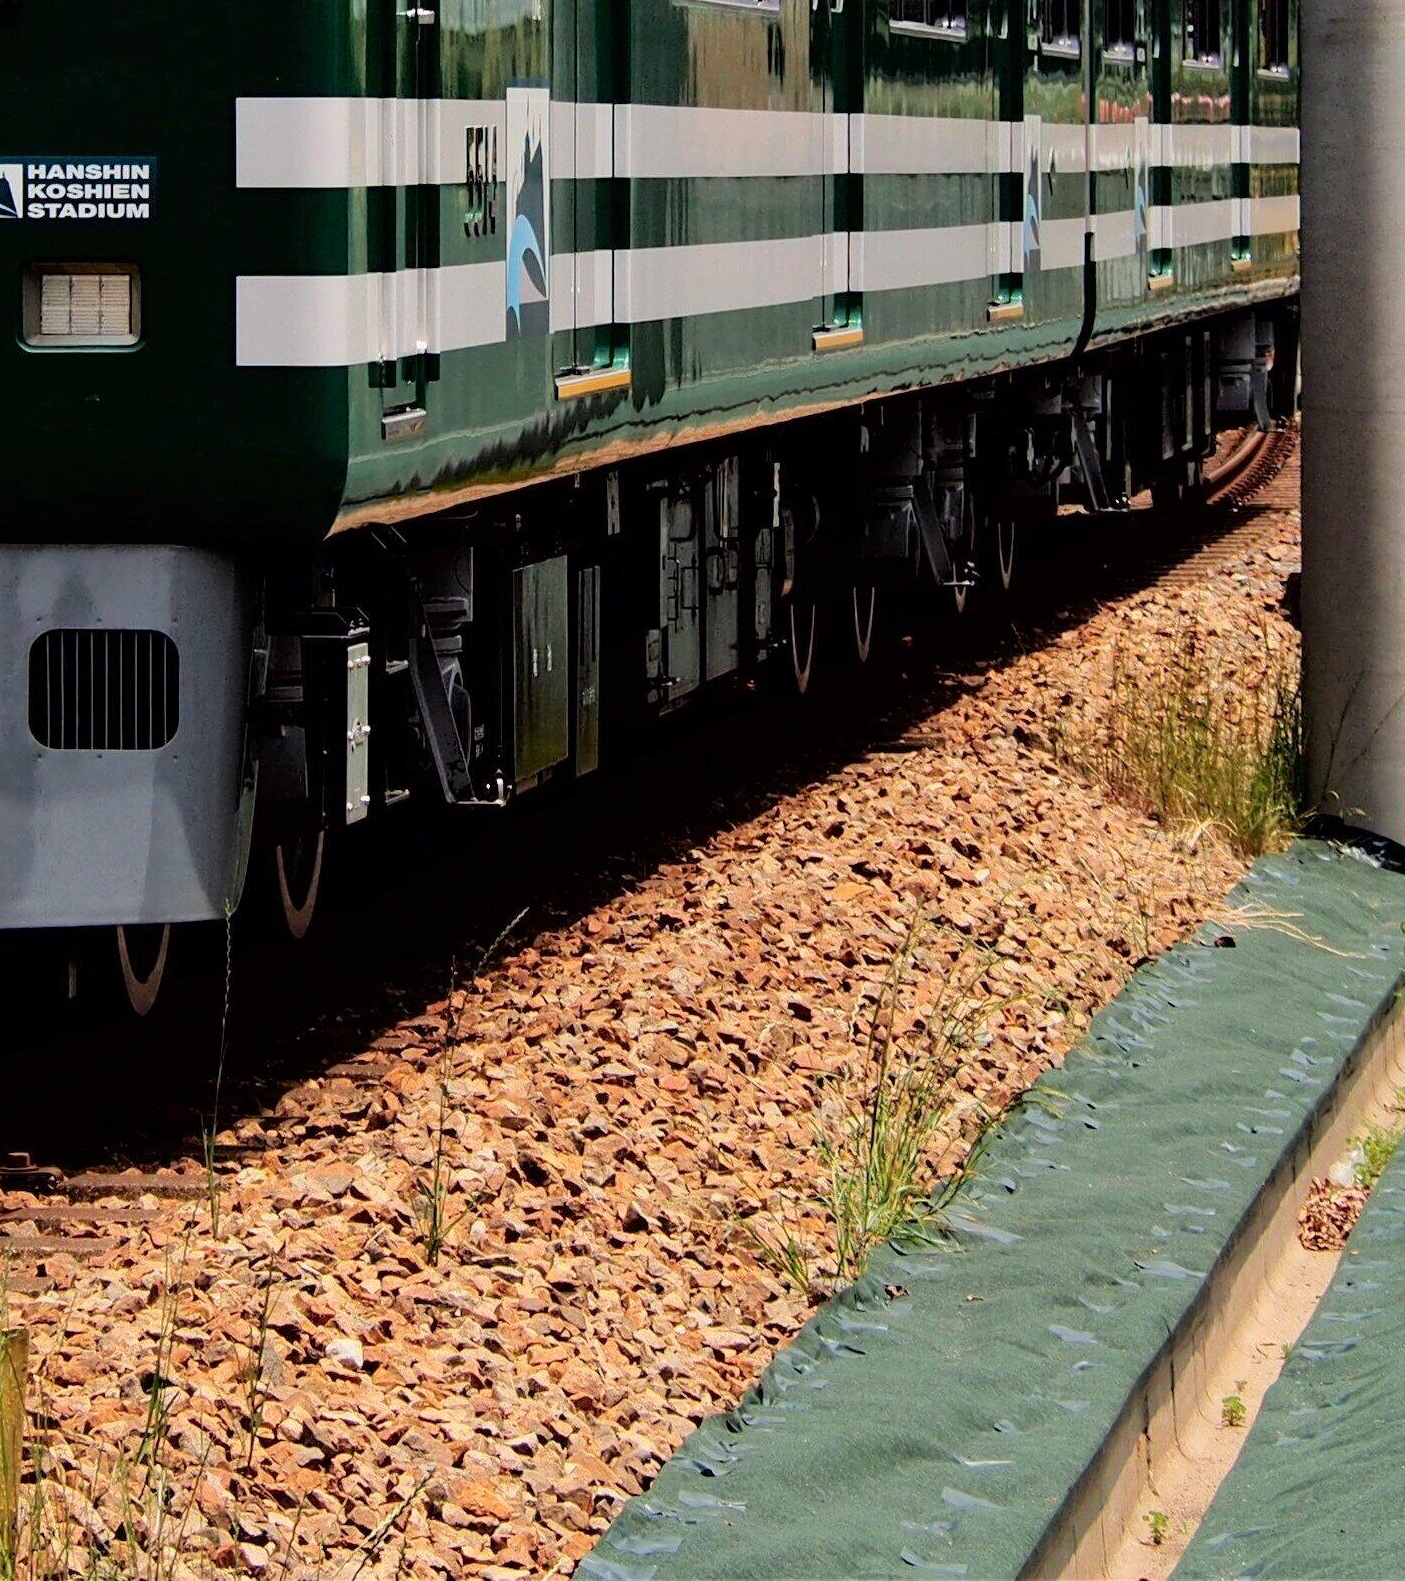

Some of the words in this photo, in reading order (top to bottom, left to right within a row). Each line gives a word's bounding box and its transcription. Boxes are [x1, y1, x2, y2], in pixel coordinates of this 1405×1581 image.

[27, 164, 150, 180] HANSHIN
[27, 183, 150, 199] KOSHIEN
[27, 202, 150, 219] STADIUM
